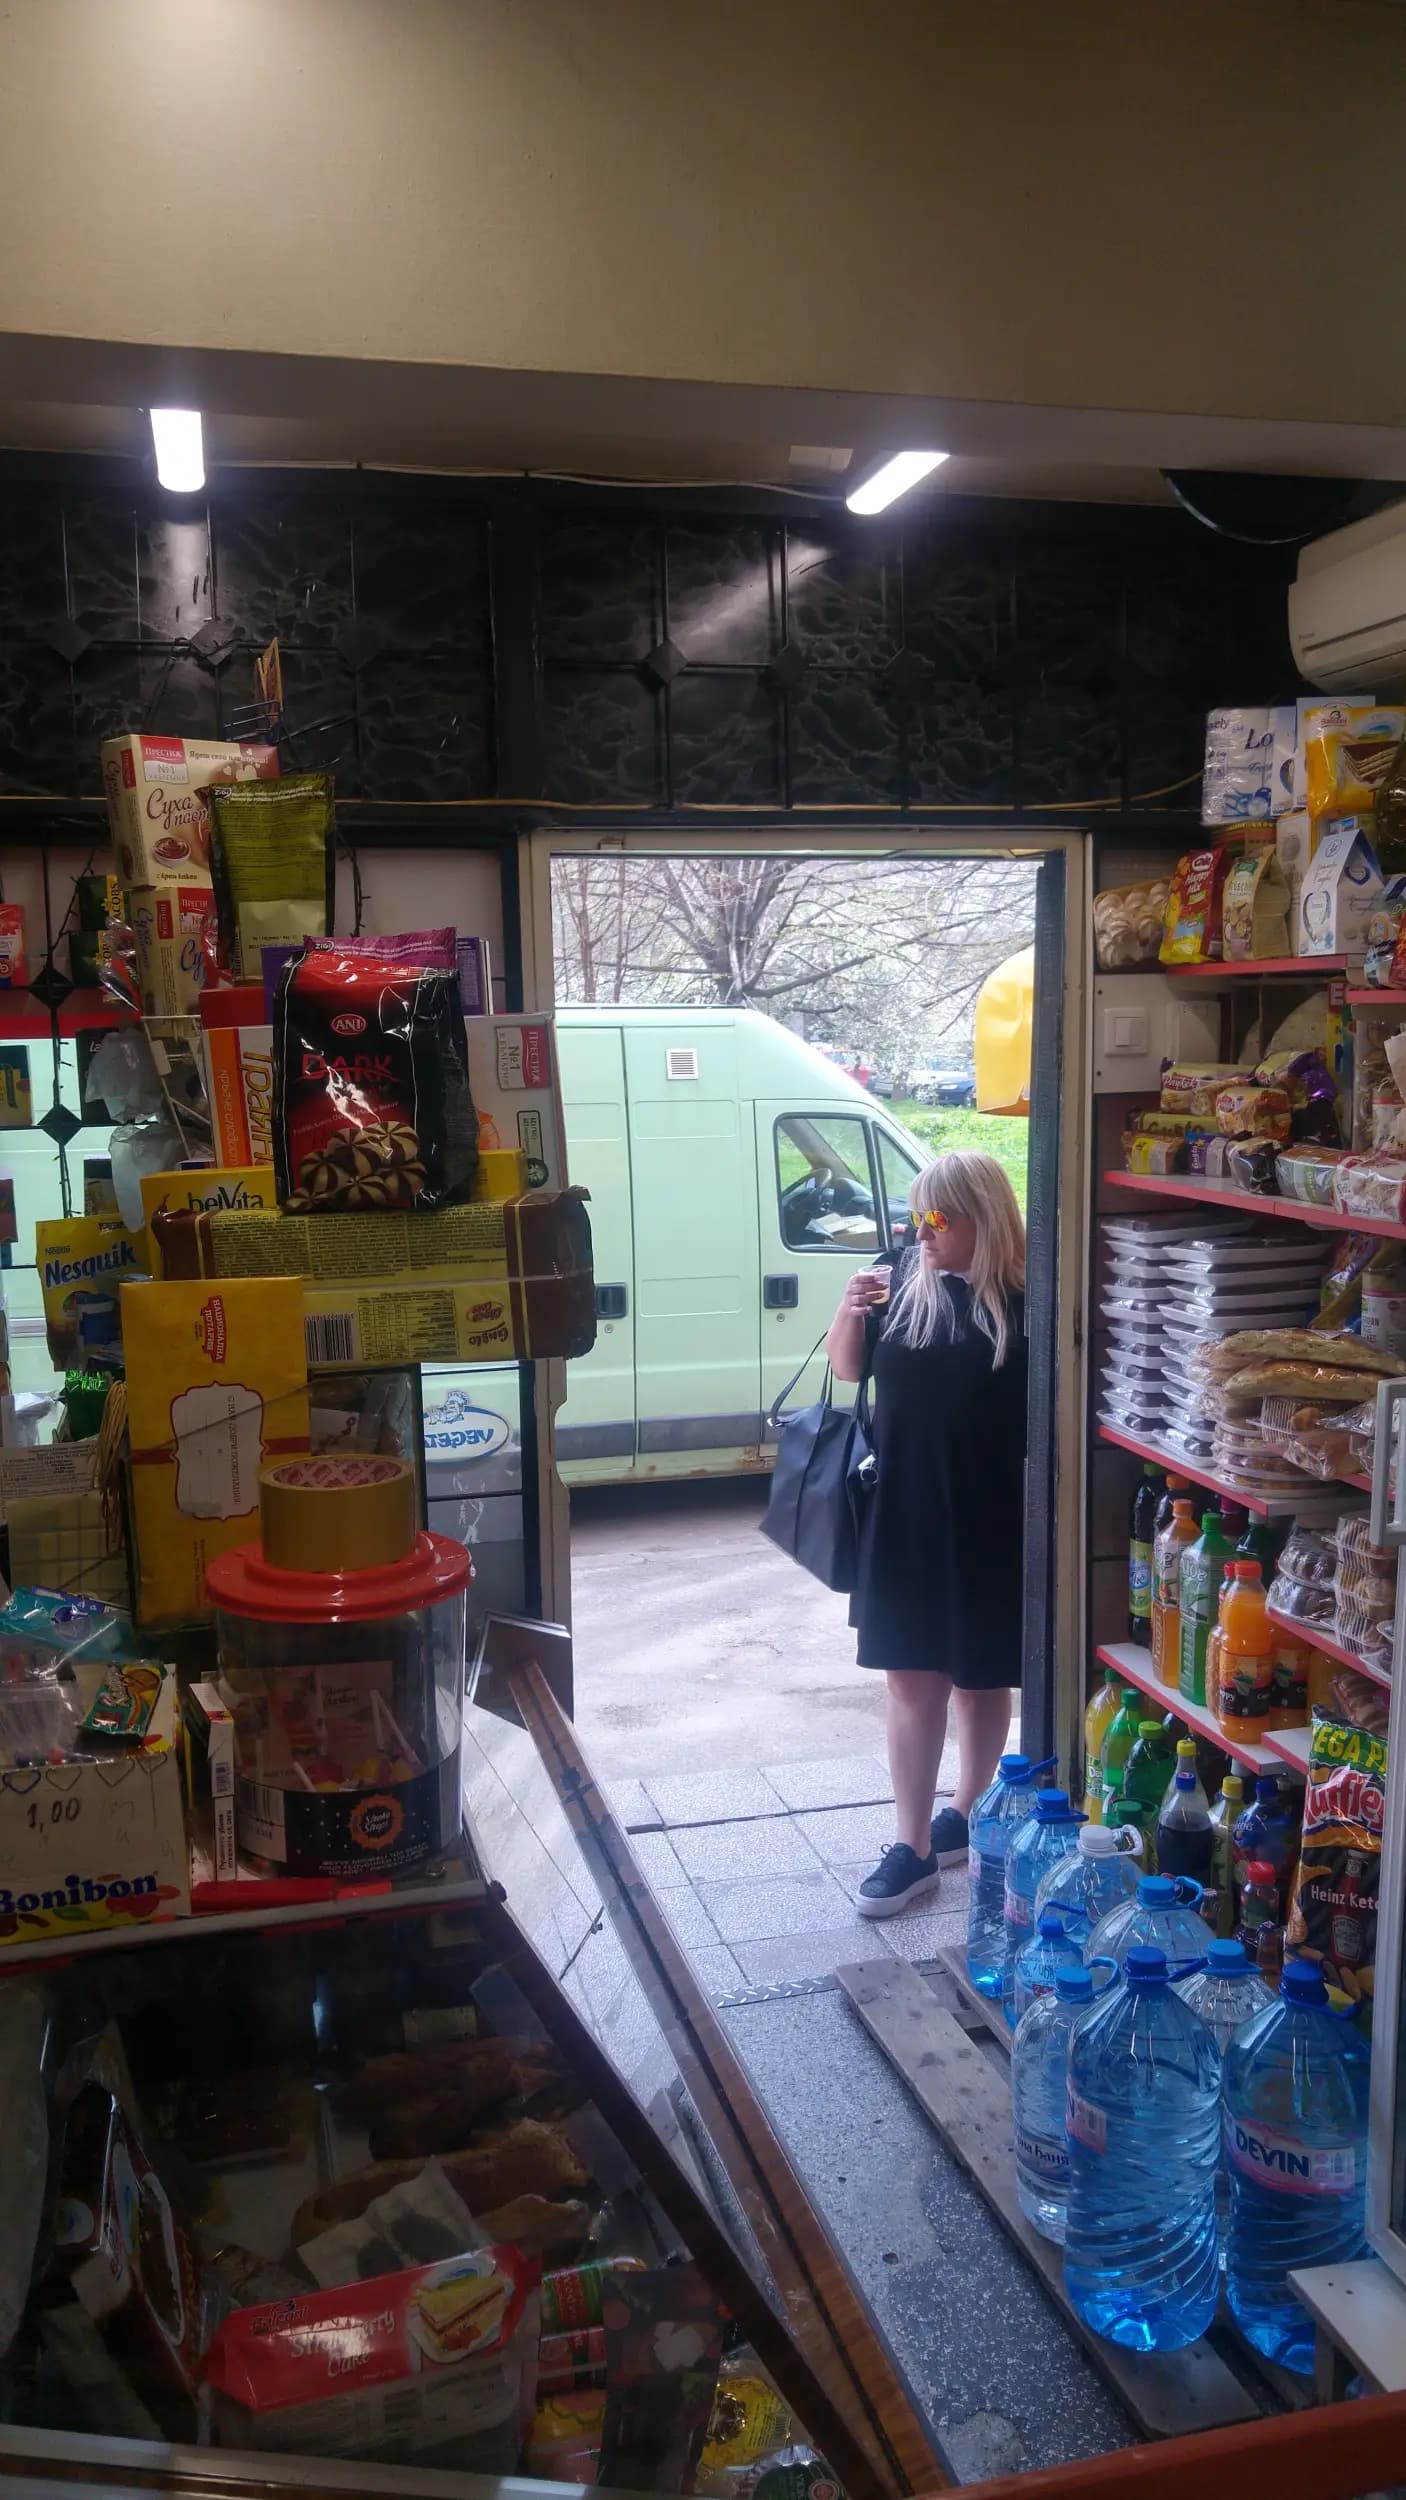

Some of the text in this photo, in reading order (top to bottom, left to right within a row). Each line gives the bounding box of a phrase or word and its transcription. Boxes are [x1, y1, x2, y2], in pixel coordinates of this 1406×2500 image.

[144, 747, 183, 758] ПРЕСТИЖ
[145, 787, 195, 830] Суха
[110, 882, 121, 921] ACOBS
[335, 1019, 363, 1031] ANI
[301, 1053, 393, 1084] DARK
[509, 1046, 521, 1070] №1
[528, 1031, 541, 1083] ПРЕСТИЖ
[187, 1180, 264, 1211] belVita
[45, 1240, 136, 1290] Nesquik
[204, 1308, 214, 1351] ЛОТАРИЯ
[214, 1298, 225, 1361] НАЦИОНАЛНА
[1314, 1726, 1388, 1772] EGA P
[27, 1797, 80, 1834] 1,00
[1311, 1884, 1346, 1906] Heinz
[1235, 2125, 1311, 2178] DEVIN
